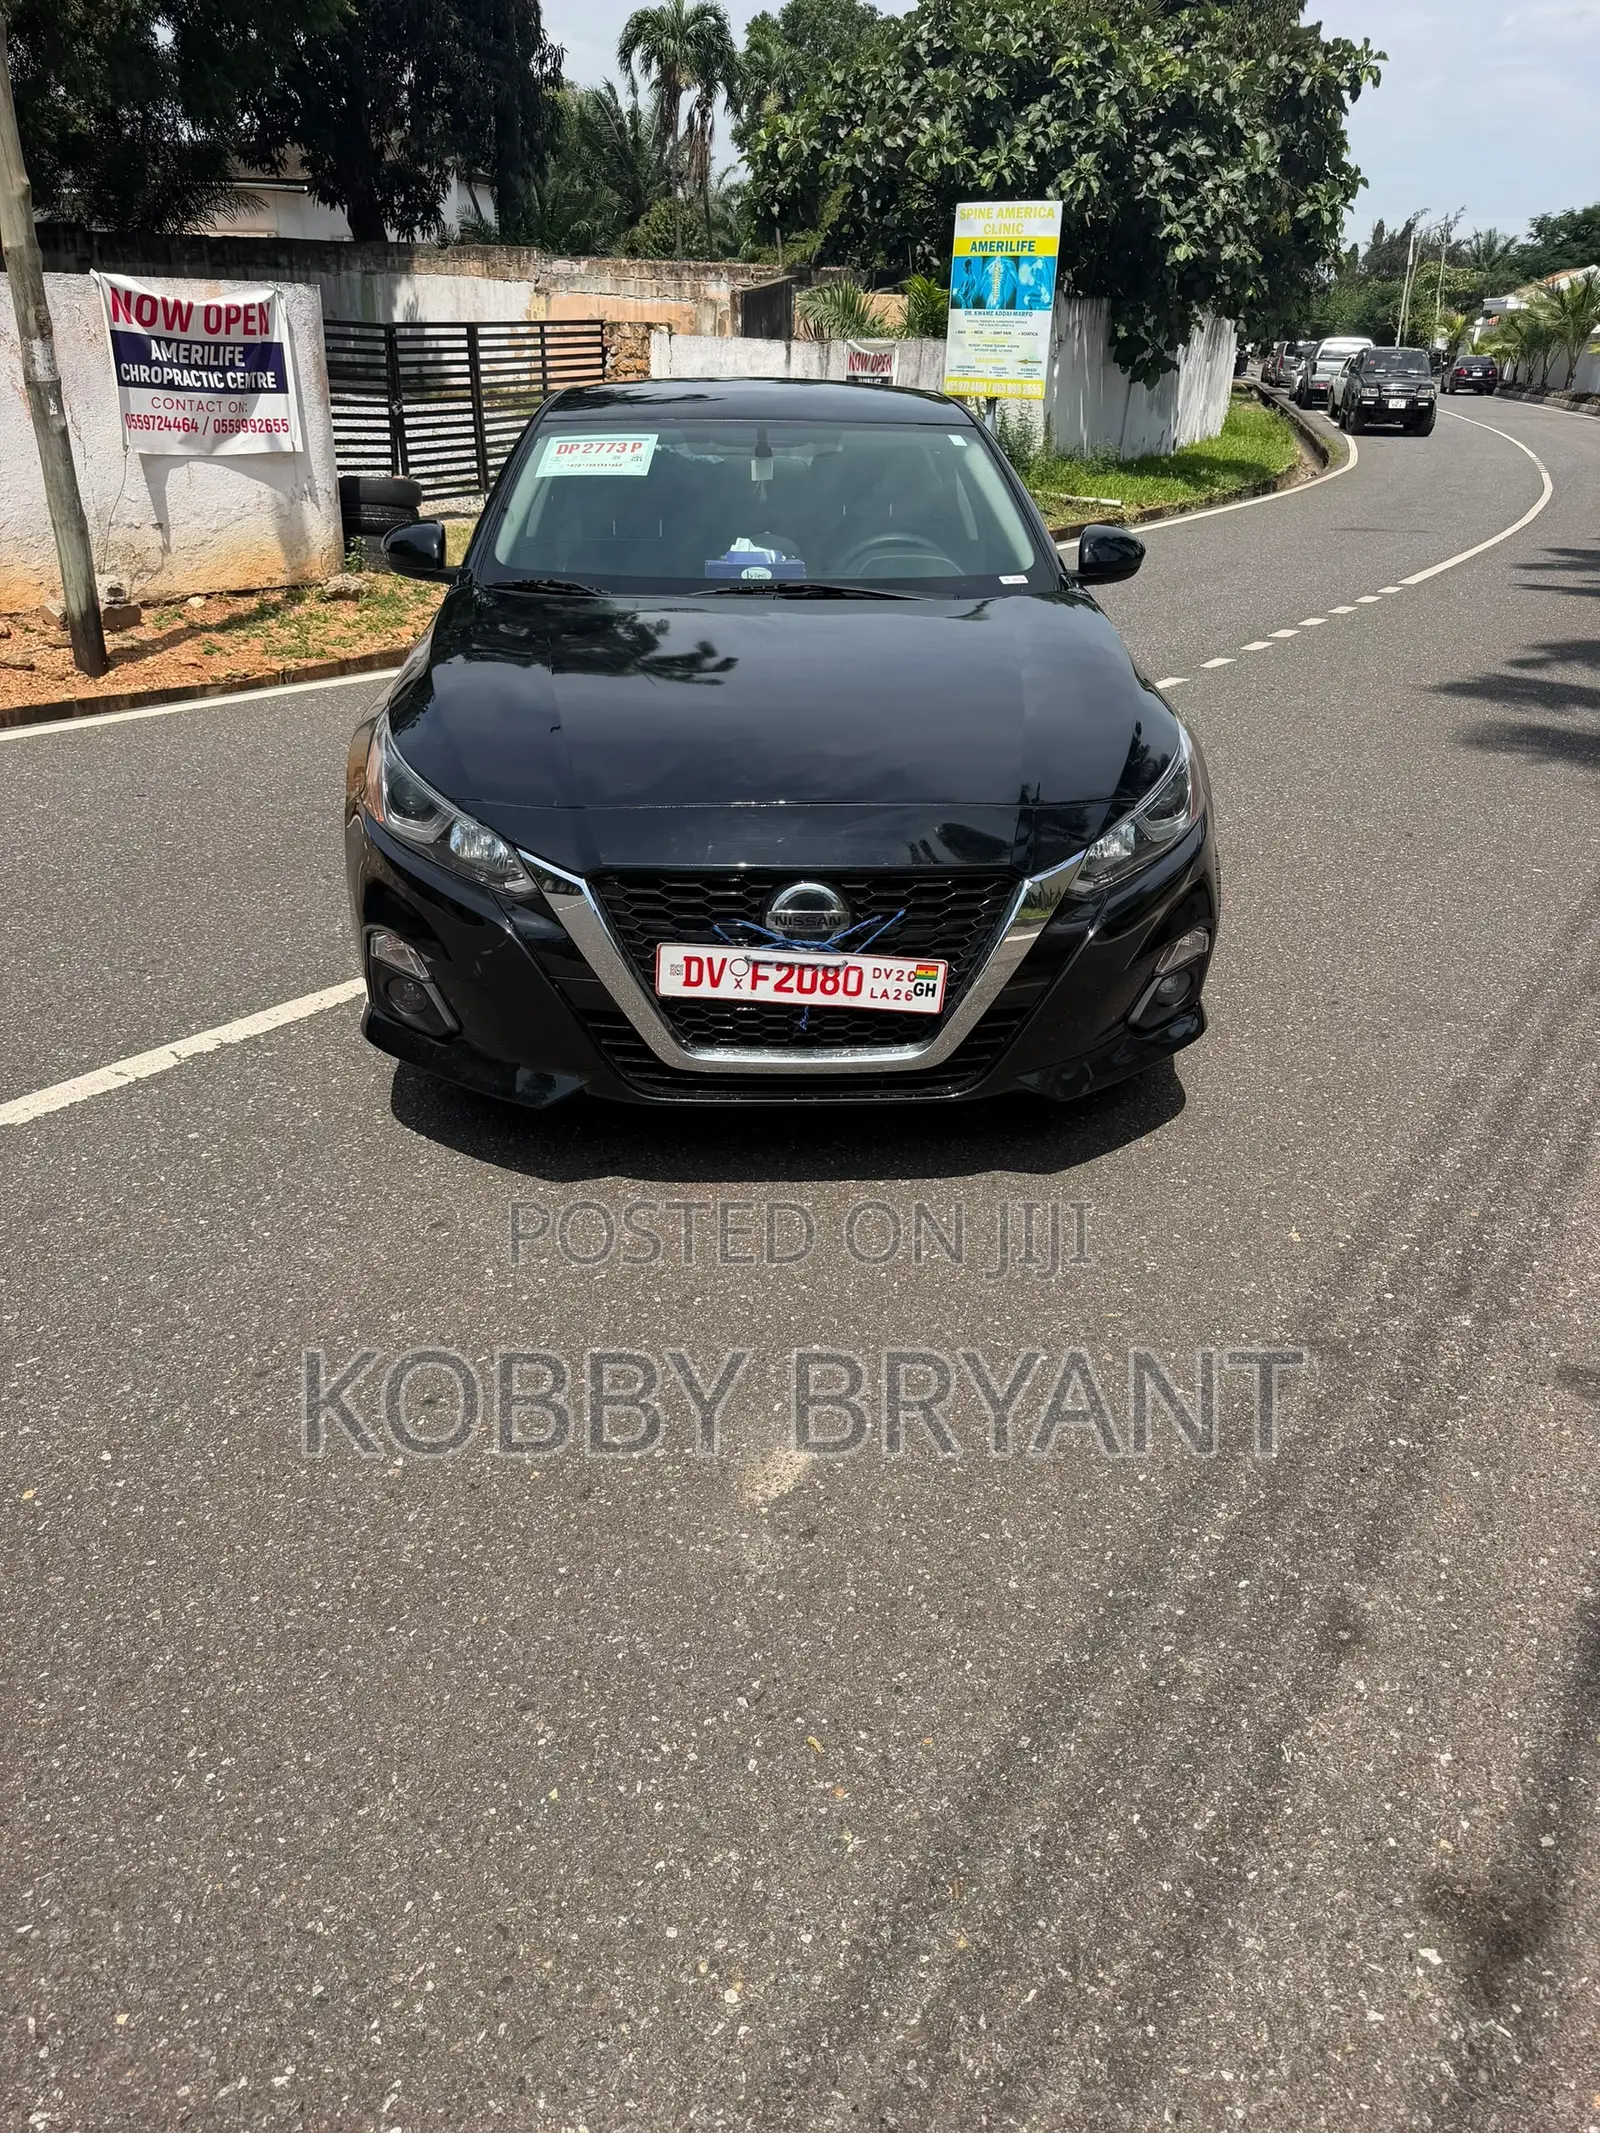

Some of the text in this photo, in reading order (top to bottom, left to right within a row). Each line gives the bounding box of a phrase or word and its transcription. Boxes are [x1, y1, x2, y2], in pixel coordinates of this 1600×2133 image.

[960, 206, 1055, 220] SPINE AMERICA
[983, 222, 1024, 235] CLINIC
[970, 240, 1036, 253] AMERILIFE
[109, 287, 271, 336] NOW OPEN
[151, 339, 246, 368] AMERILIFE
[848, 351, 893, 373] NOW OPEN
[120, 362, 278, 390] CHROPRACTIC CENTRE
[151, 396, 248, 414] CONTACT ON:
[125, 412, 290, 436] 0559724464 / 0559992655
[556, 442, 643, 455] DP 2773 P
[774, 913, 842, 928] NISSAN
[682, 955, 864, 998] DV F2080
[869, 987, 914, 1002] LA26
[912, 981, 937, 998] GH
